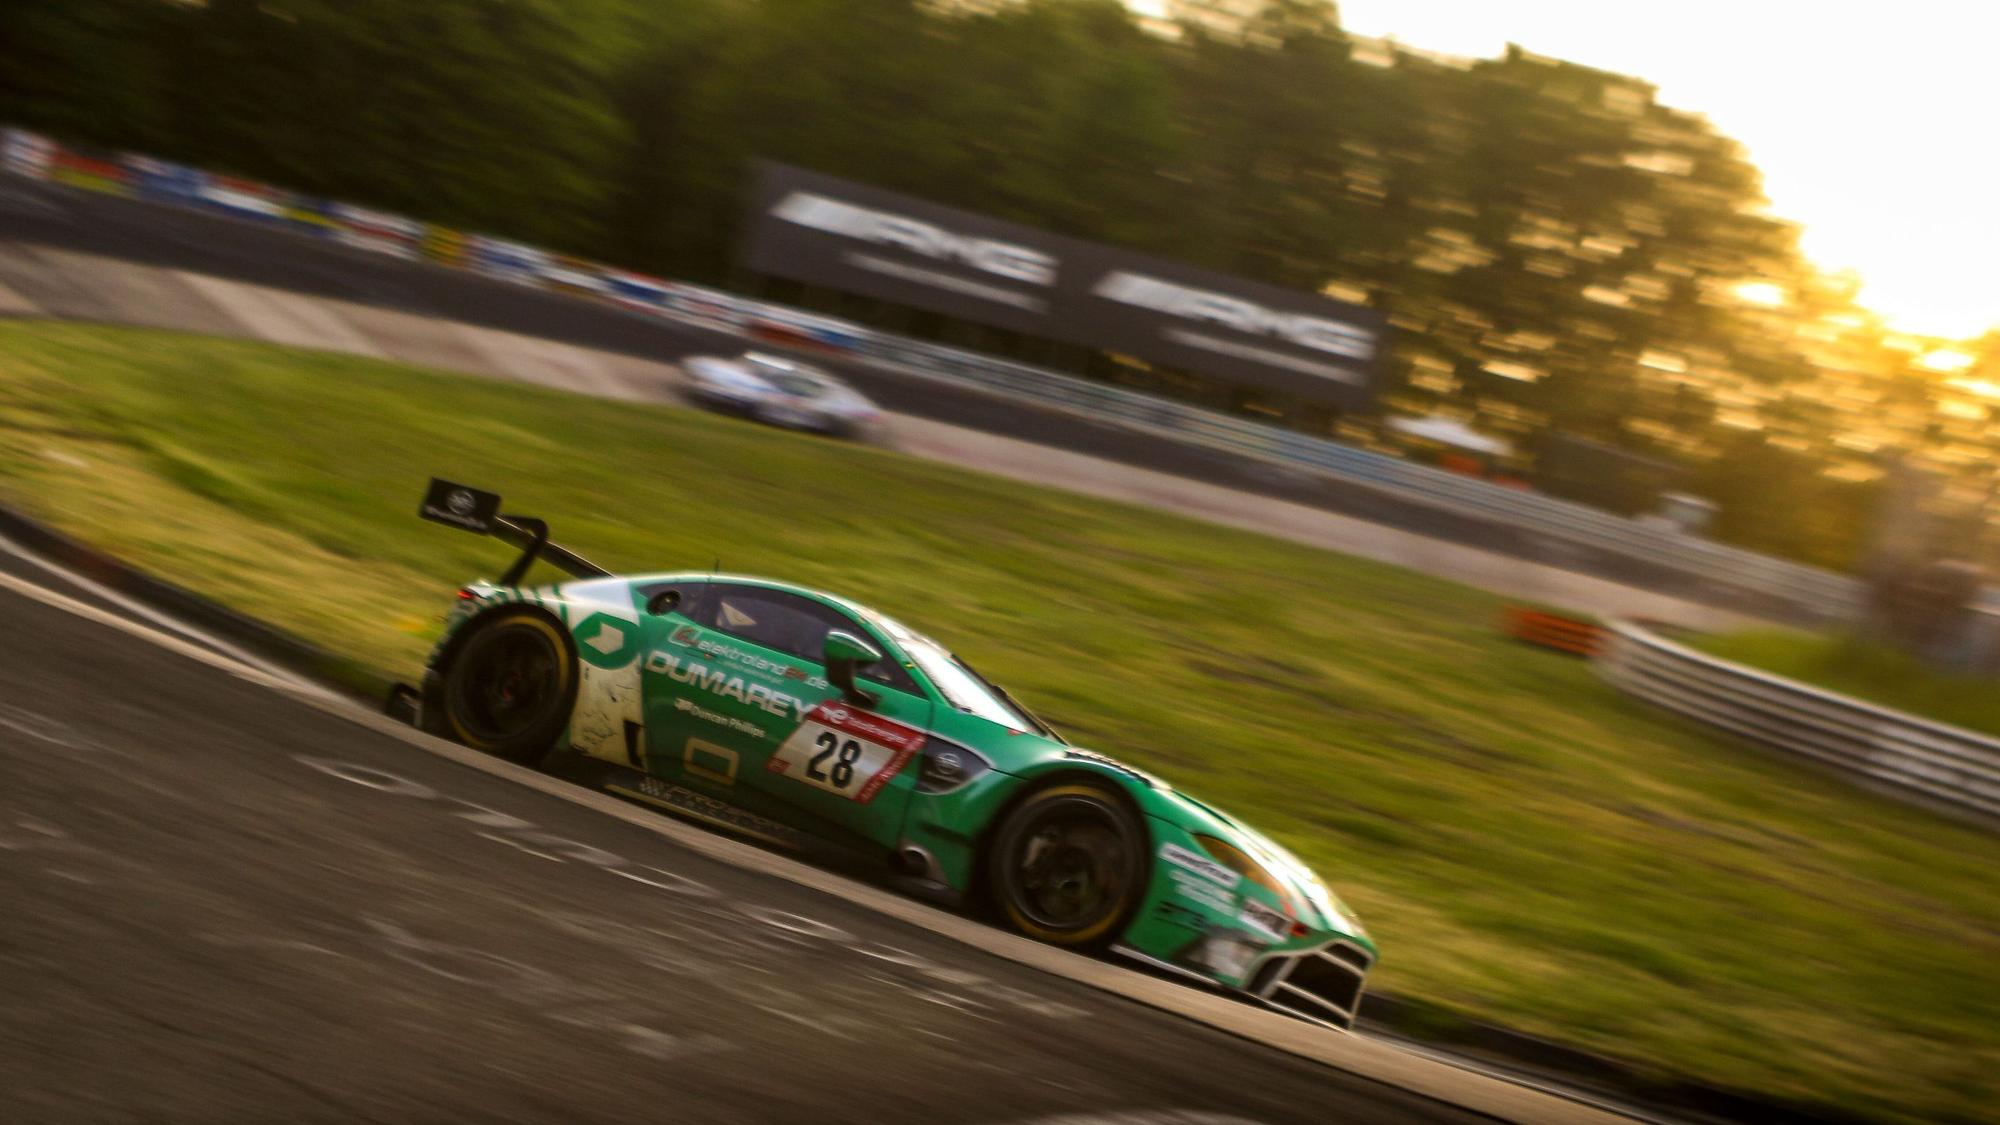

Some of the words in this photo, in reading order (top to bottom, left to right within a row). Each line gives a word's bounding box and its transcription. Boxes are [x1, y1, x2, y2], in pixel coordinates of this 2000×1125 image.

[645, 650, 818, 722] DUMAREY
[690, 705, 729, 728] Duncan
[729, 716, 766, 738] Phillips
[806, 731, 862, 789] 28
